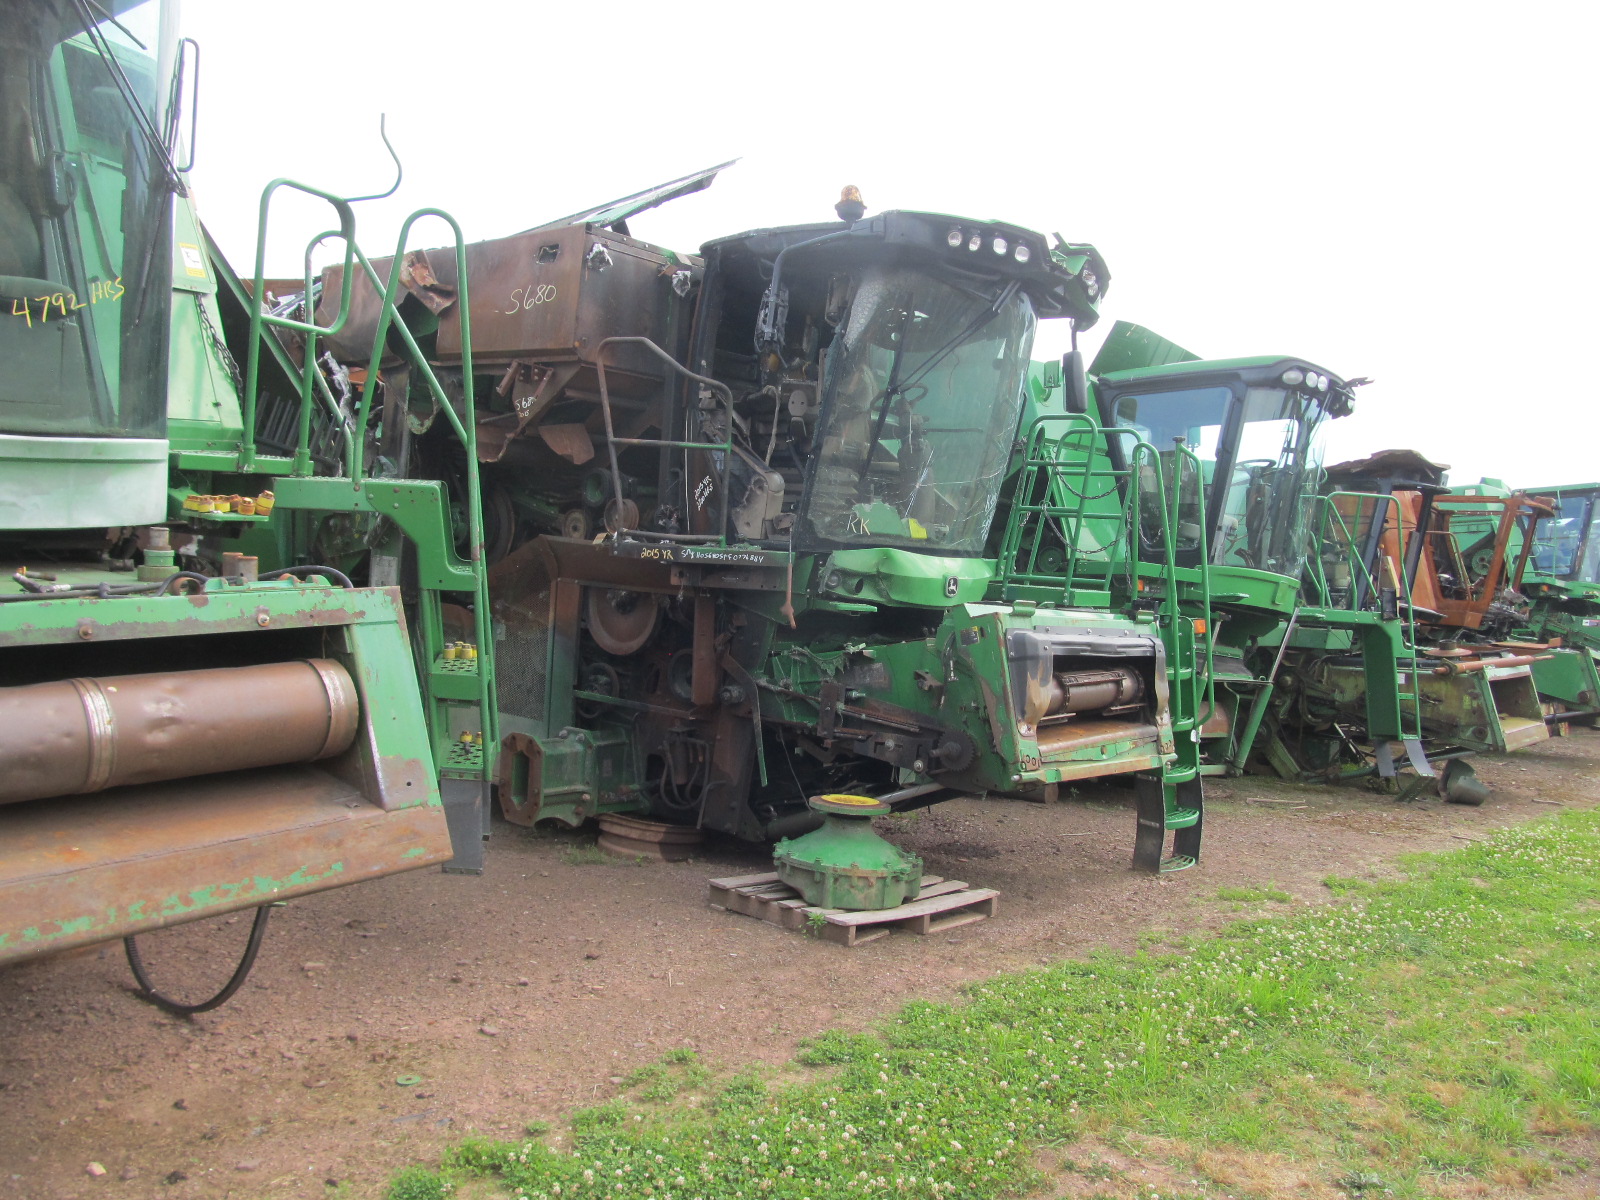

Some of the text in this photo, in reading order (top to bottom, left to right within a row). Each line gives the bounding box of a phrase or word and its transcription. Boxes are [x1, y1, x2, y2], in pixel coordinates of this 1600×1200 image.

[12, 277, 125, 329] 4792 HRS
[505, 284, 557, 314] S680
[640, 547, 674, 560] 2015 YR
